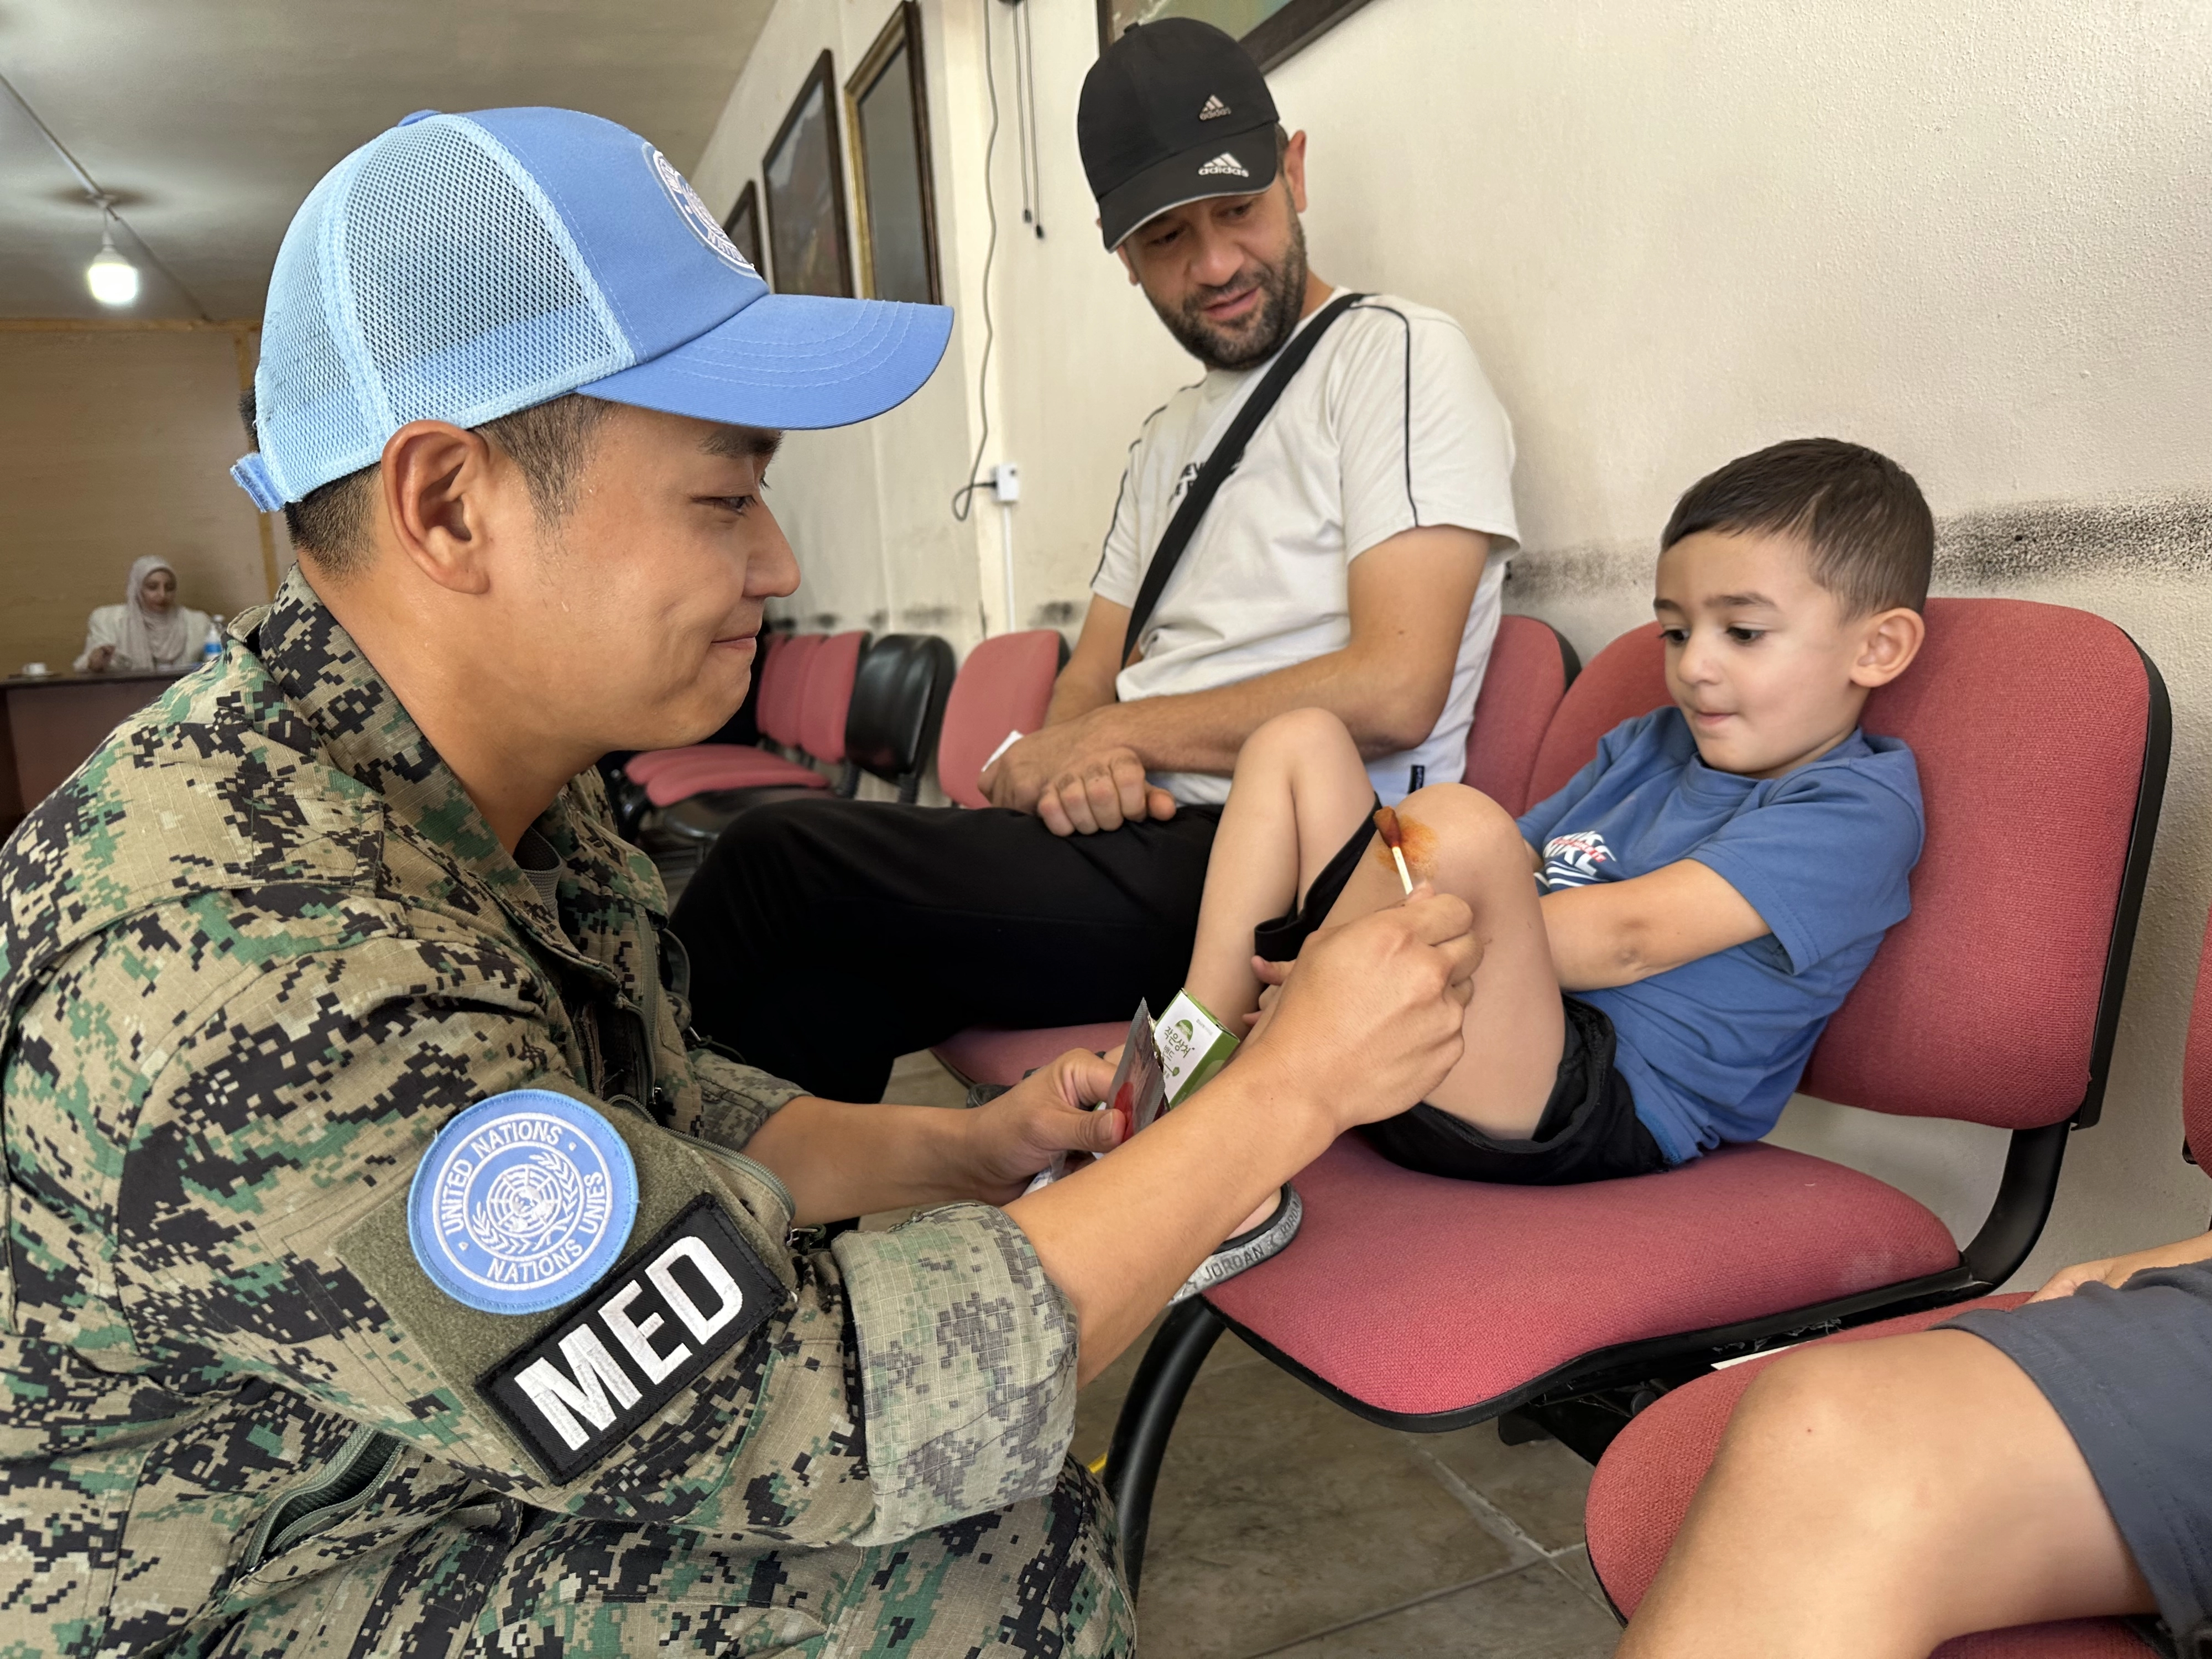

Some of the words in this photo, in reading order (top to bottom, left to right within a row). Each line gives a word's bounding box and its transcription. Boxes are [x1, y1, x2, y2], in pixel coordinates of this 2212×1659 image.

[1199, 107, 1232, 121] adidas
[1198, 166, 1249, 178] adidas
[1164, 1026, 1191, 1058] 작은상처
[441, 1160, 472, 1235] UNITED
[471, 1120, 563, 1156] NATIONS
[487, 1239, 585, 1284] NATIONS
[579, 1171, 604, 1234] UNIES
[1204, 1244, 1265, 1282] JORDAN
[514, 1236, 743, 1451] MED
